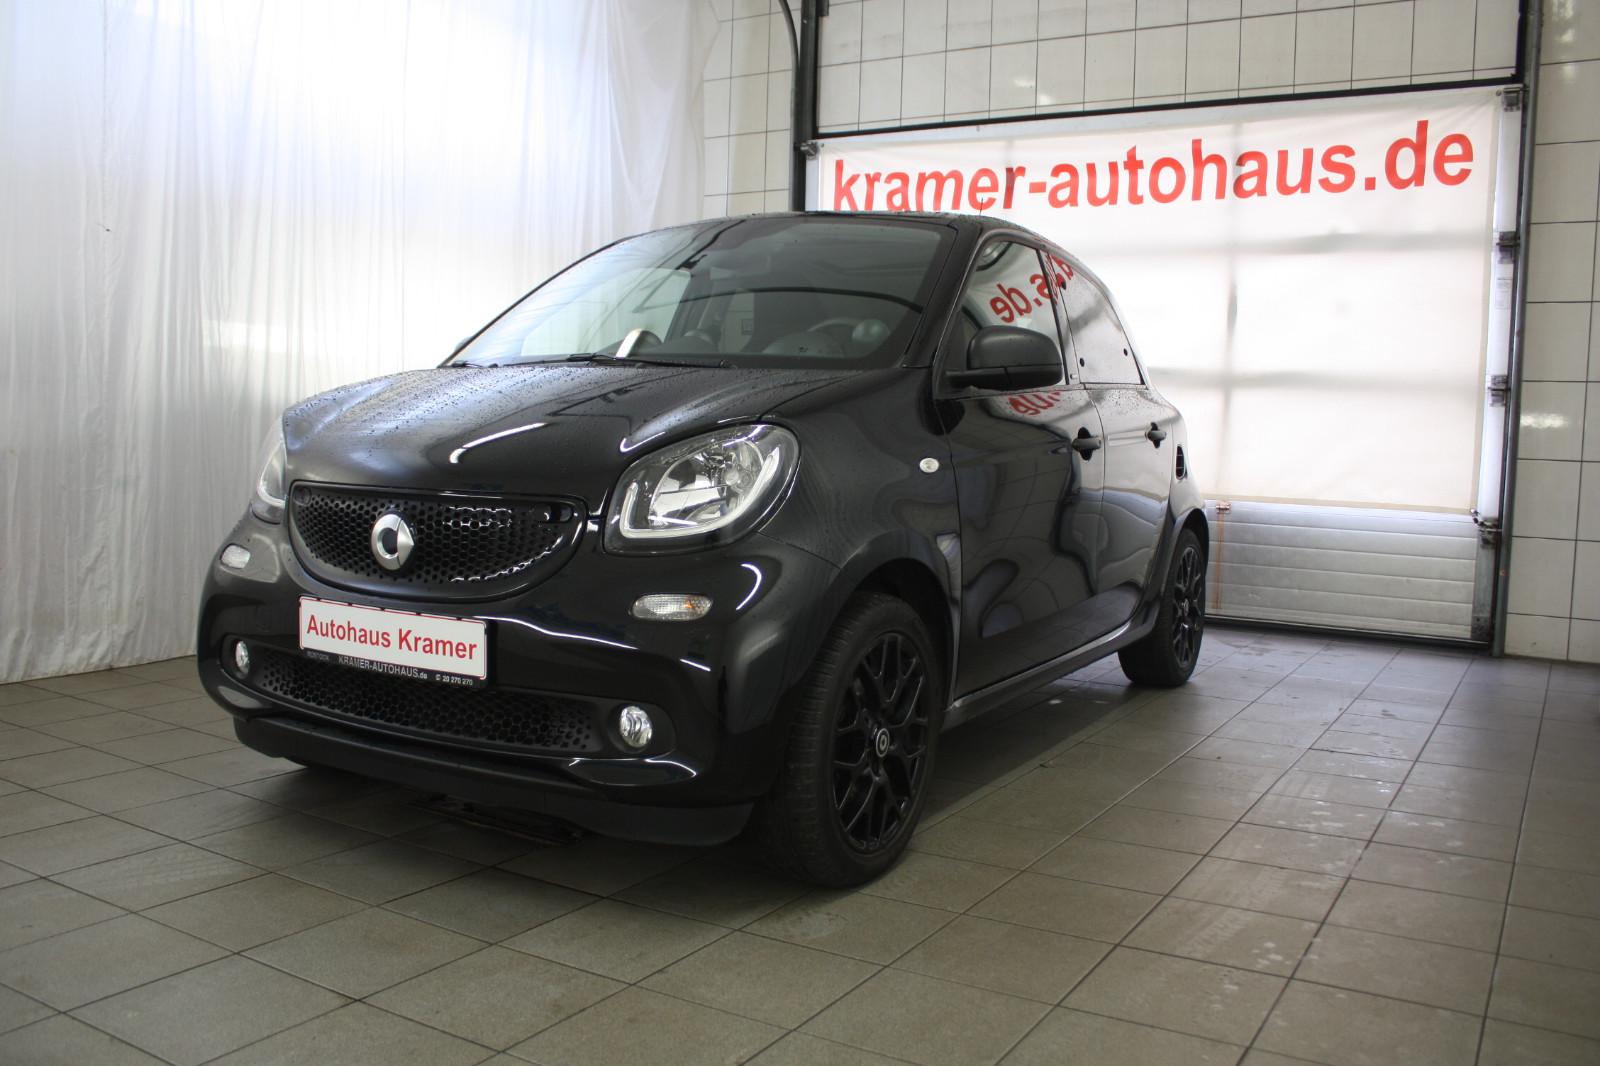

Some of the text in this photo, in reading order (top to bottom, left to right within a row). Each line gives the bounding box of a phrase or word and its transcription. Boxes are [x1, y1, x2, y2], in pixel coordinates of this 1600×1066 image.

[833, 120, 1474, 212] kramer-autohaus.de
[306, 614, 478, 660] Autohaus Kramer
[338, 655, 428, 680] KRAMER-AUTOHAUS.de
